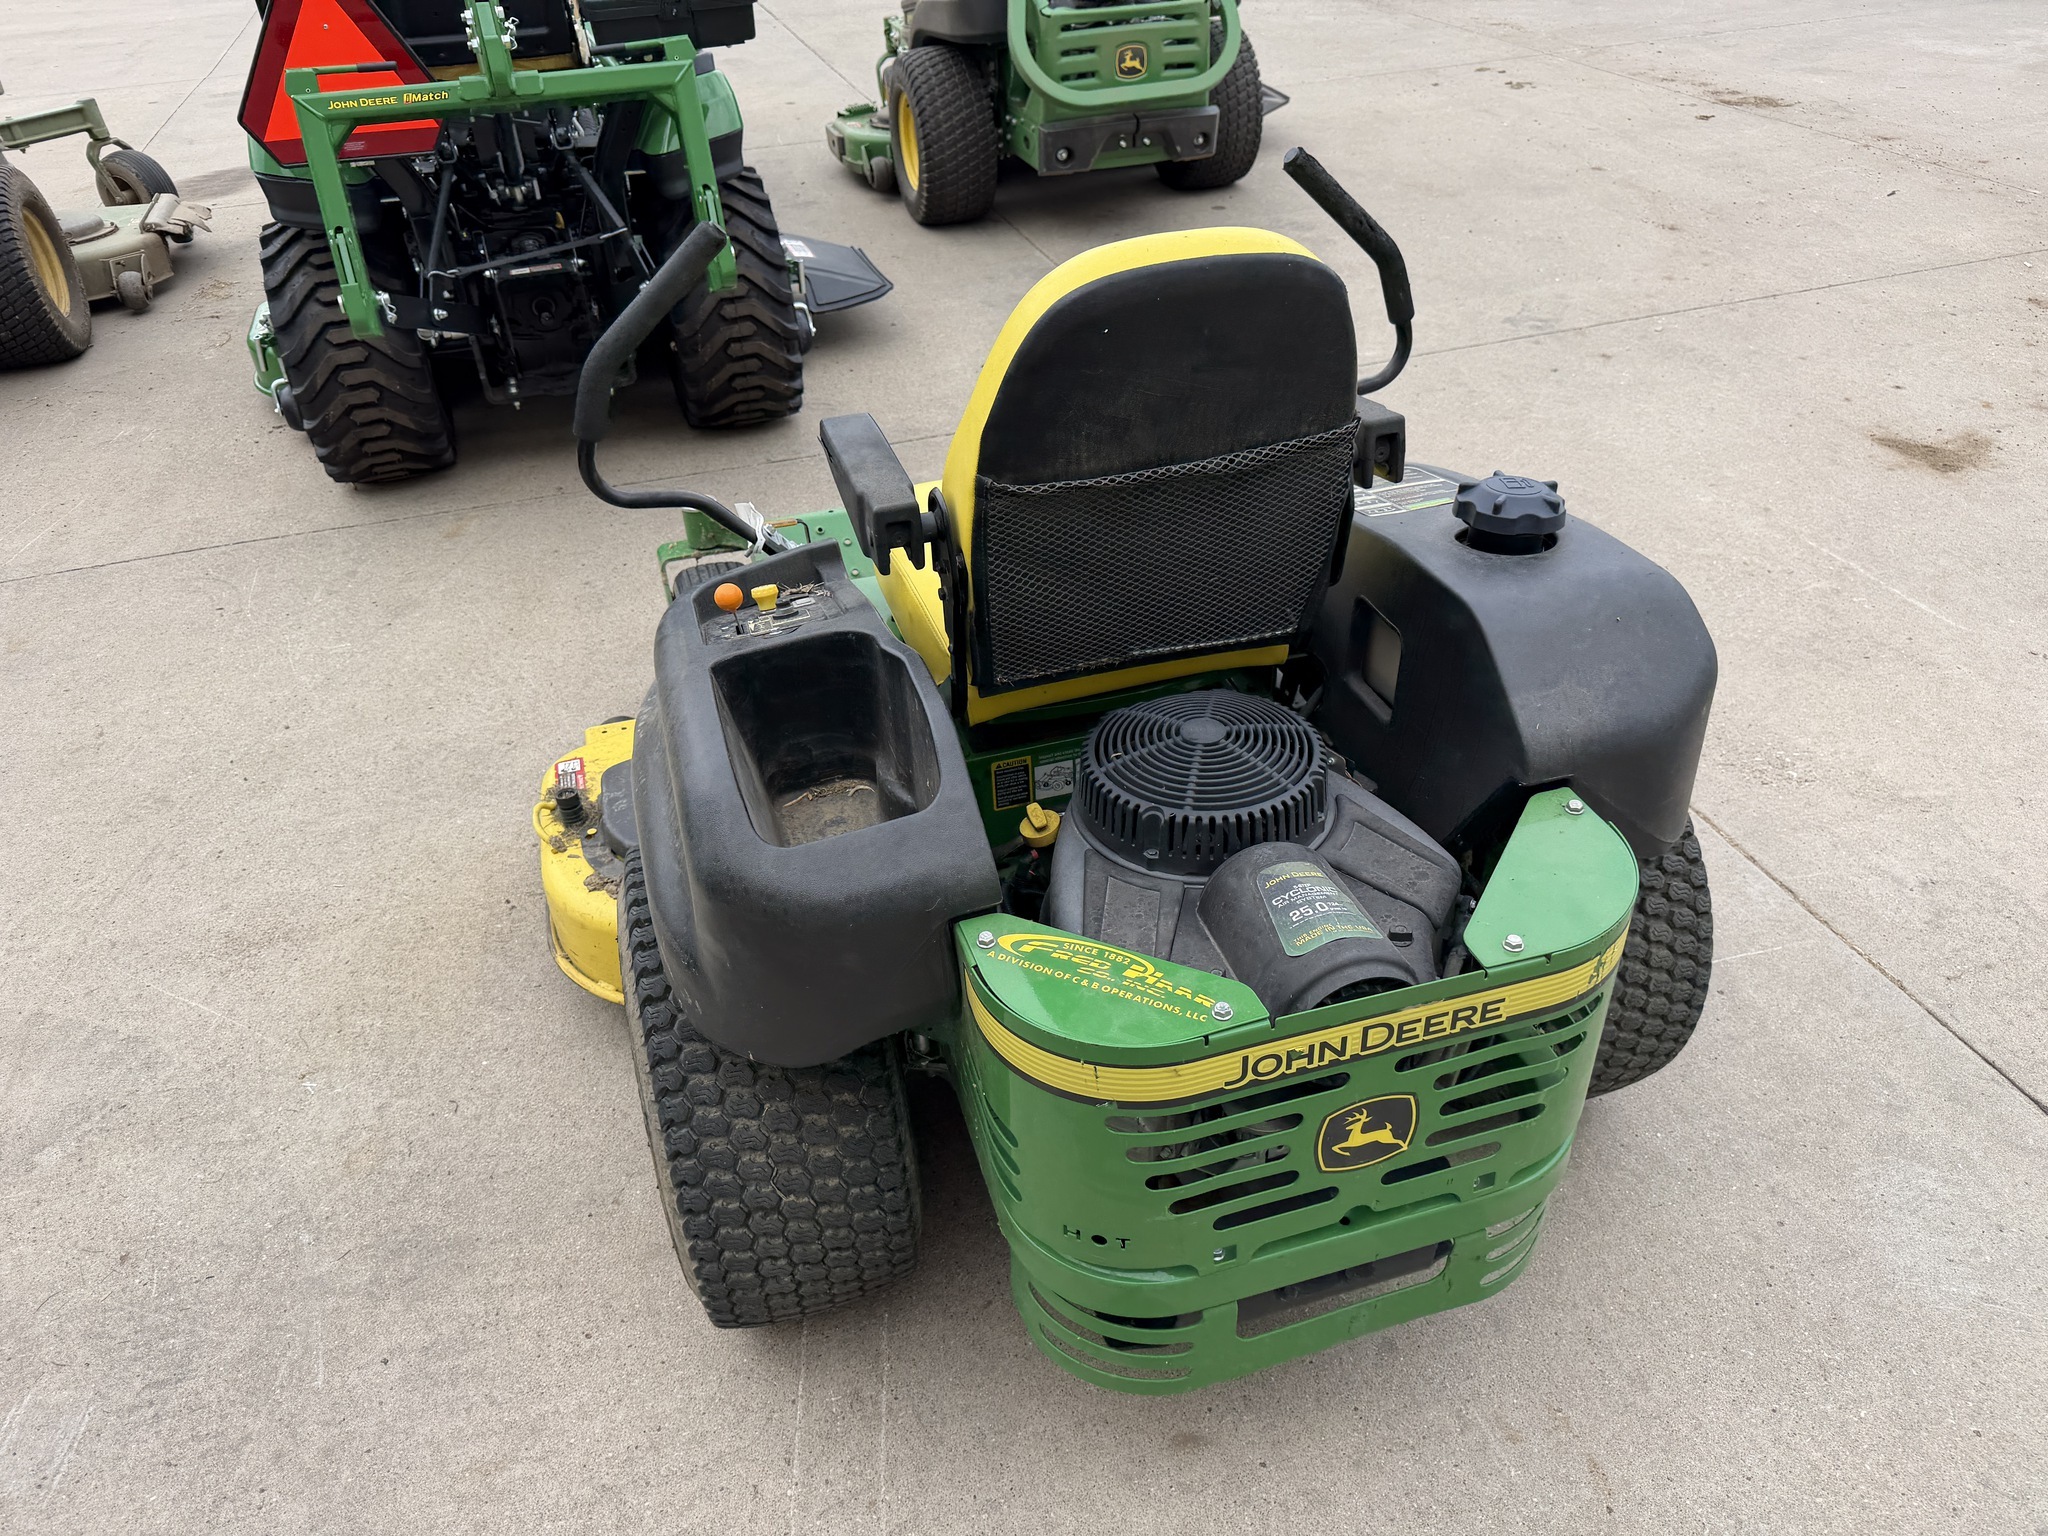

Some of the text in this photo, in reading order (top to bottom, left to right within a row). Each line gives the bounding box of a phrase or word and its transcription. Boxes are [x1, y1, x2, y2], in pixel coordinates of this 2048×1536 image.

[327, 98, 358, 110] JOHN
[359, 96, 398, 107] DEERE
[1002, 758, 1027, 768] CAUTION
[1265, 873, 1291, 889] JOHN
[1271, 885, 1338, 906] CYCLONIC
[1278, 890, 1338, 909] AIR MANAGEMENT
[1289, 901, 1329, 922] 25.0
[1295, 930, 1324, 947] MADE
[1324, 925, 1336, 933] IN
[1017, 940, 1112, 970] FRED
[1062, 942, 1131, 965] SINCE 1882
[986, 950, 1209, 1023] A DIVISION OF C & B OPERATIONS, LLC
[1224, 997, 1507, 1088] JOHN DEERE
